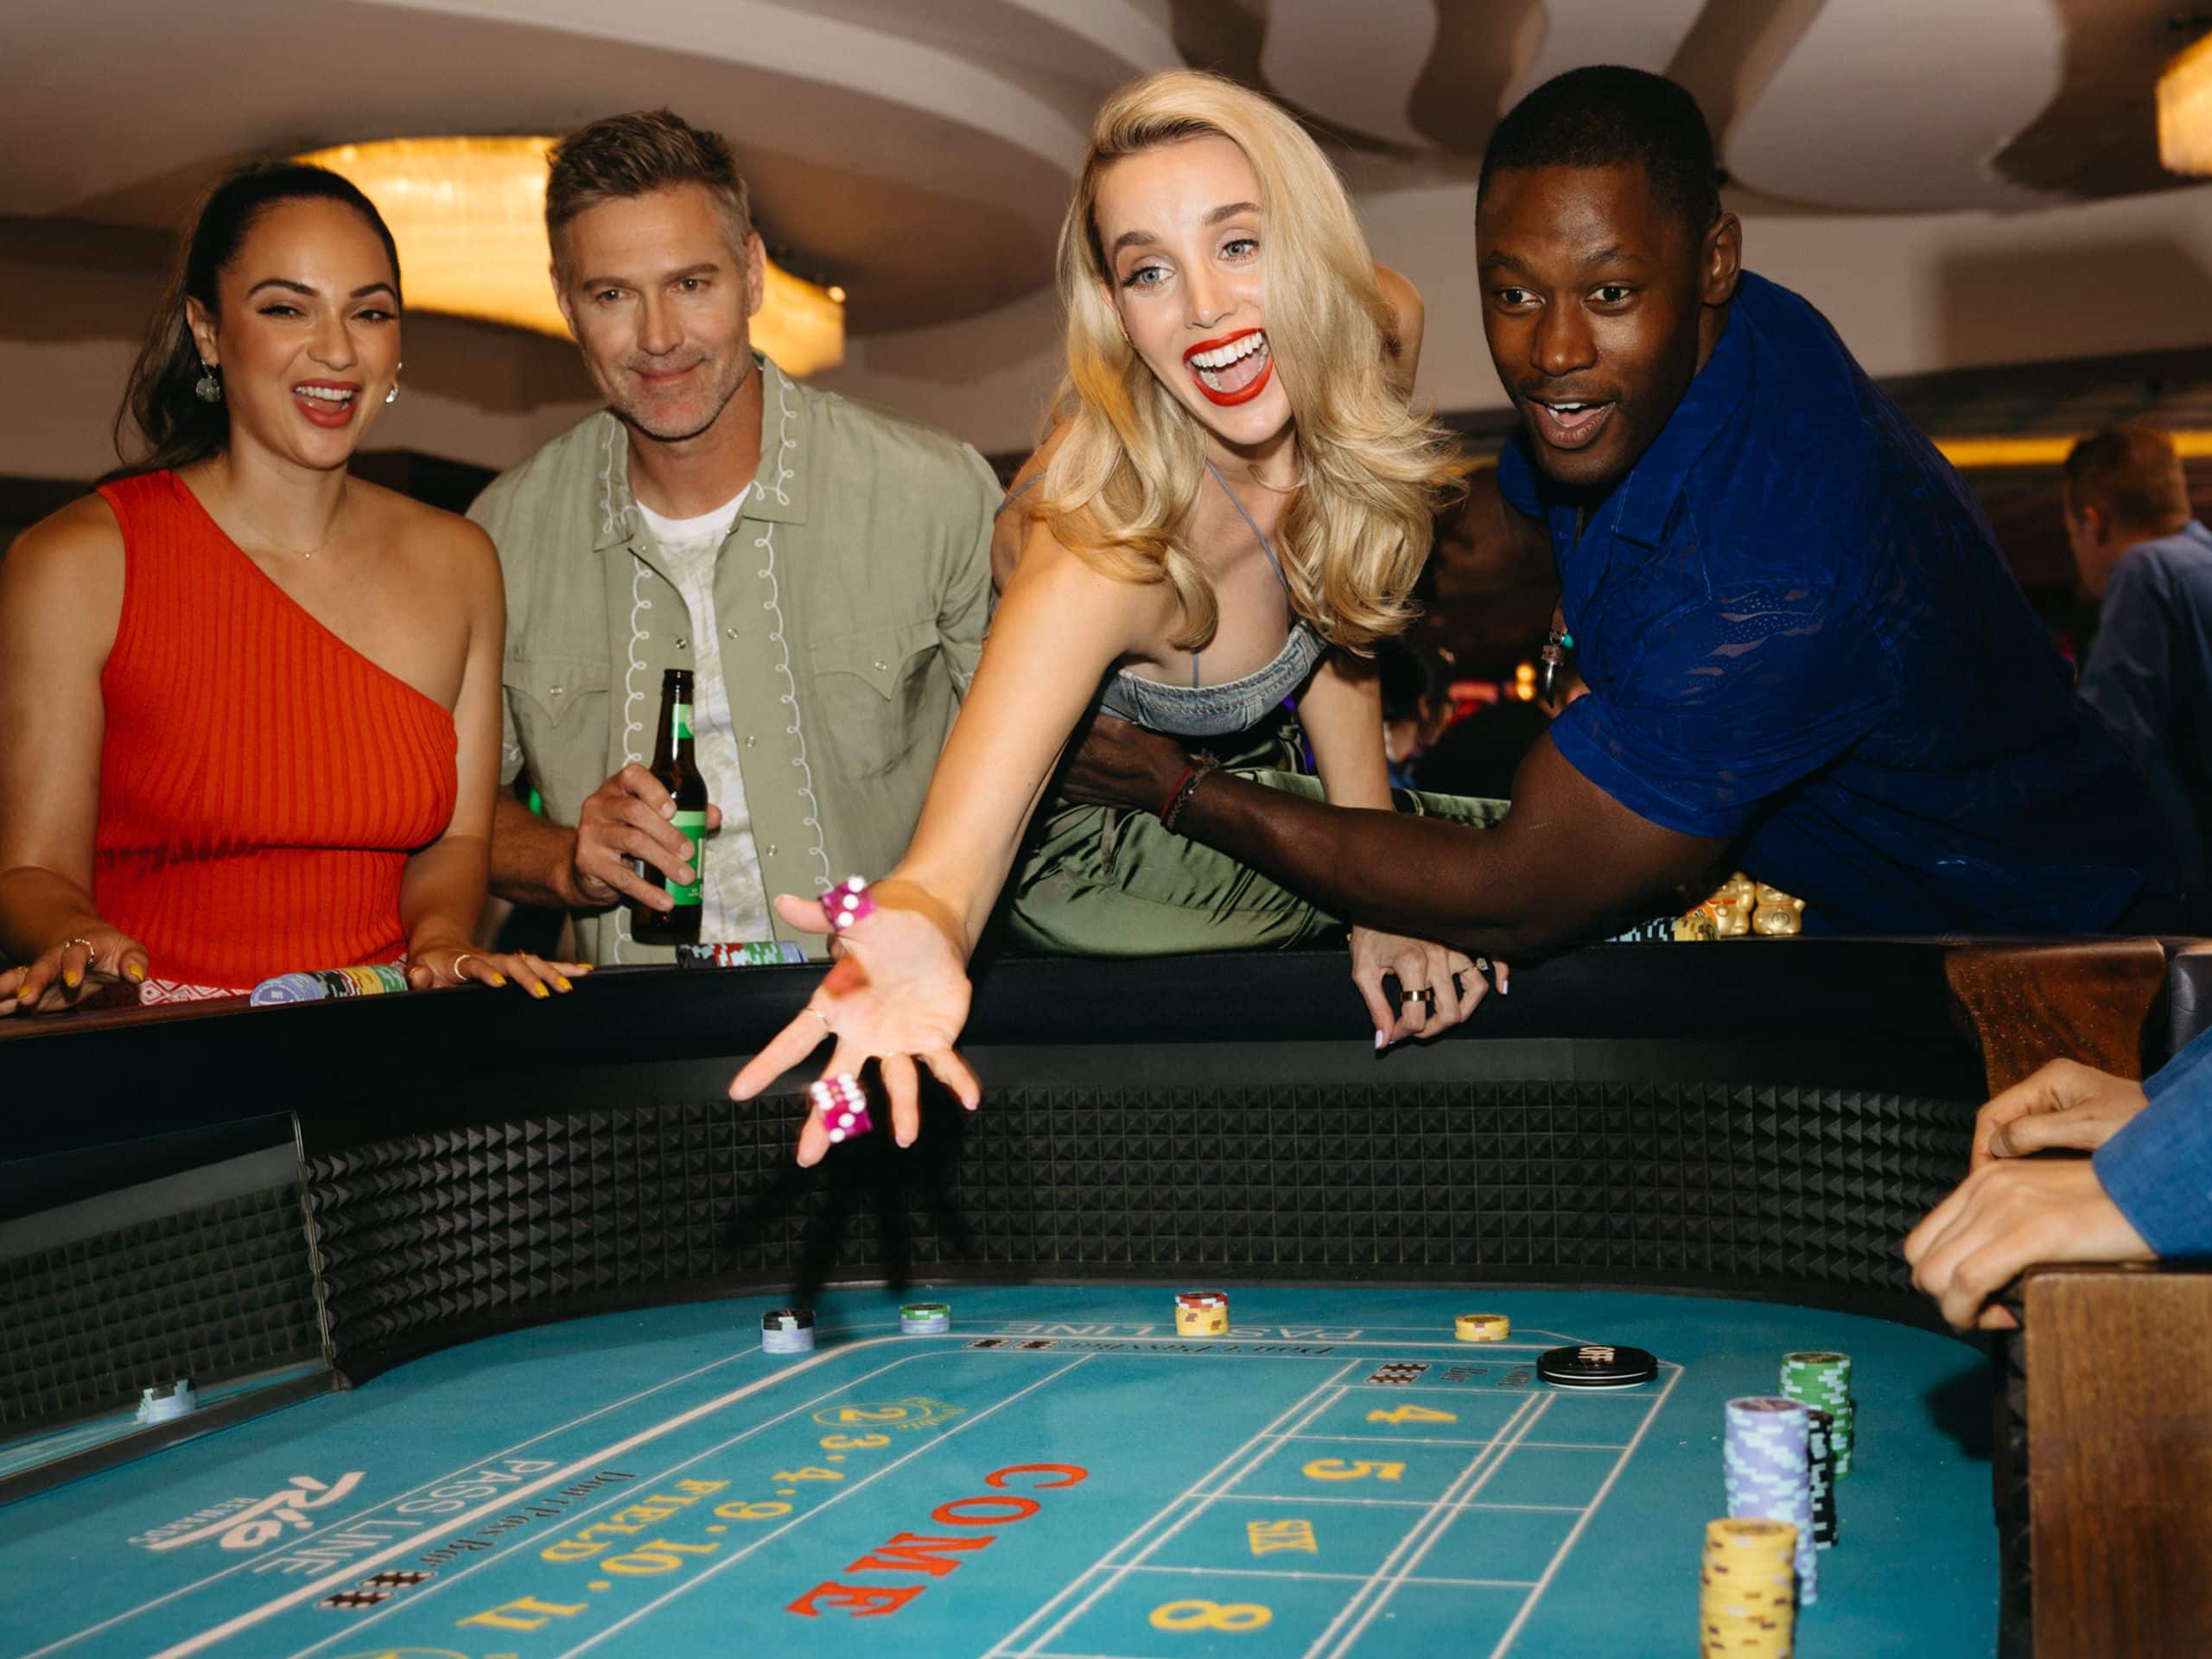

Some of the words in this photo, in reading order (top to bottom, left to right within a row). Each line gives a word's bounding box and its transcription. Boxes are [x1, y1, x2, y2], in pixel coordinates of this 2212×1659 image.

[995, 1322, 1156, 1336] LINE
[1225, 1327, 1364, 1339] PAS
[1576, 1346, 1617, 1364] OFF
[838, 1406, 908, 1424] 2
[1364, 1404, 1459, 1425] 4
[820, 1433, 891, 1452] 3
[397, 1459, 557, 1514] PASS
[771, 1466, 845, 1483] 4
[1301, 1459, 1407, 1482] 5
[144, 1471, 367, 1551] Rio
[540, 1478, 731, 1563] FIELD
[251, 1520, 423, 1575] LINE
[784, 1463, 1089, 1618] COME
[1246, 1518, 1319, 1556] SIX
[600, 1538, 725, 1575] 10
[455, 1596, 588, 1631] 11
[1147, 1599, 1274, 1631] 8
